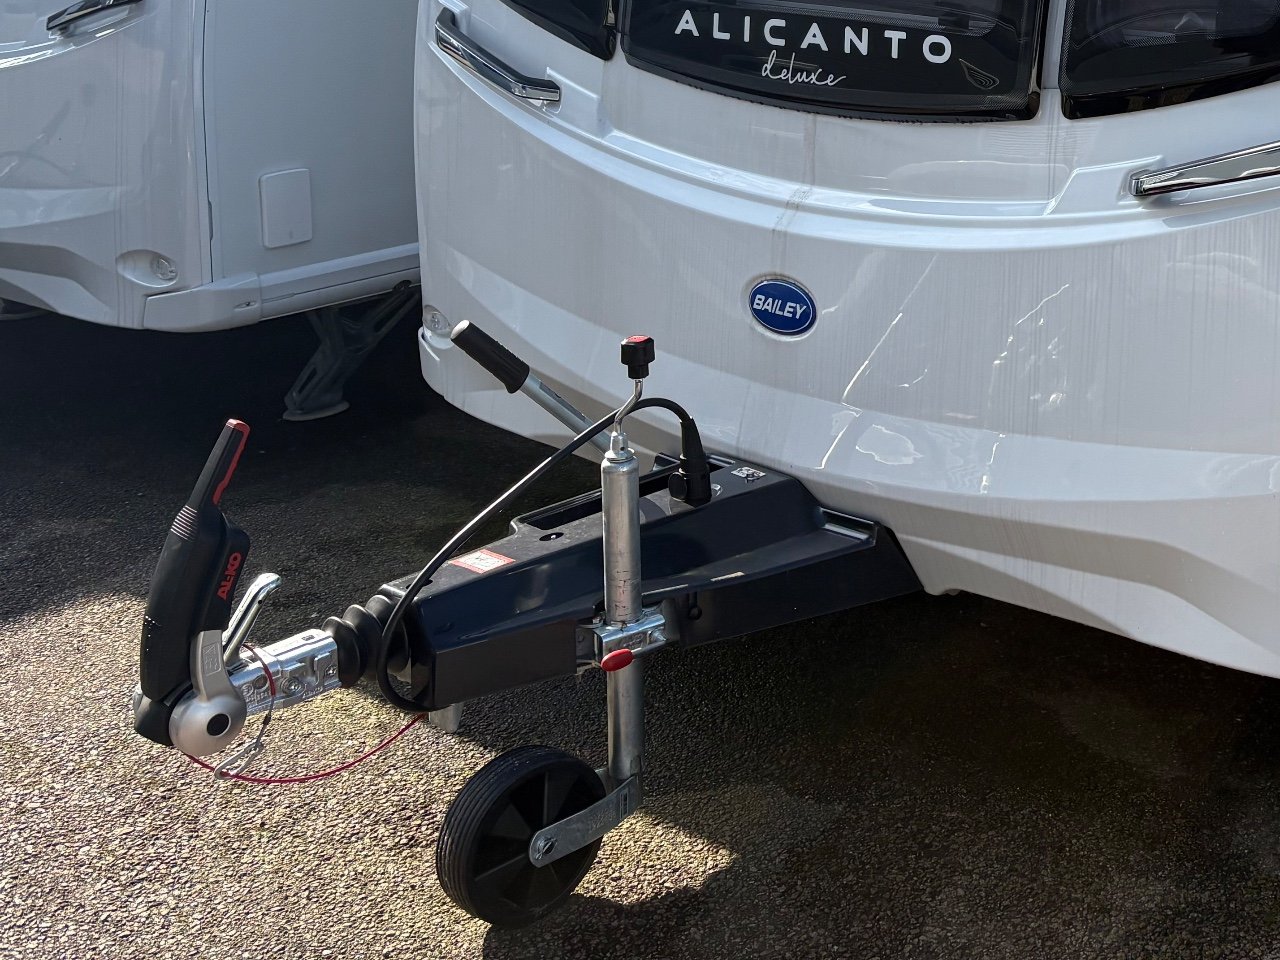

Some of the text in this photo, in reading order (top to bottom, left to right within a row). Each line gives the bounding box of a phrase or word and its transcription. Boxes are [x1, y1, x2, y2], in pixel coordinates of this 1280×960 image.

[674, 9, 952, 64] ALICANTO
[761, 49, 847, 86] deluxe
[753, 294, 807, 320] BAILEY
